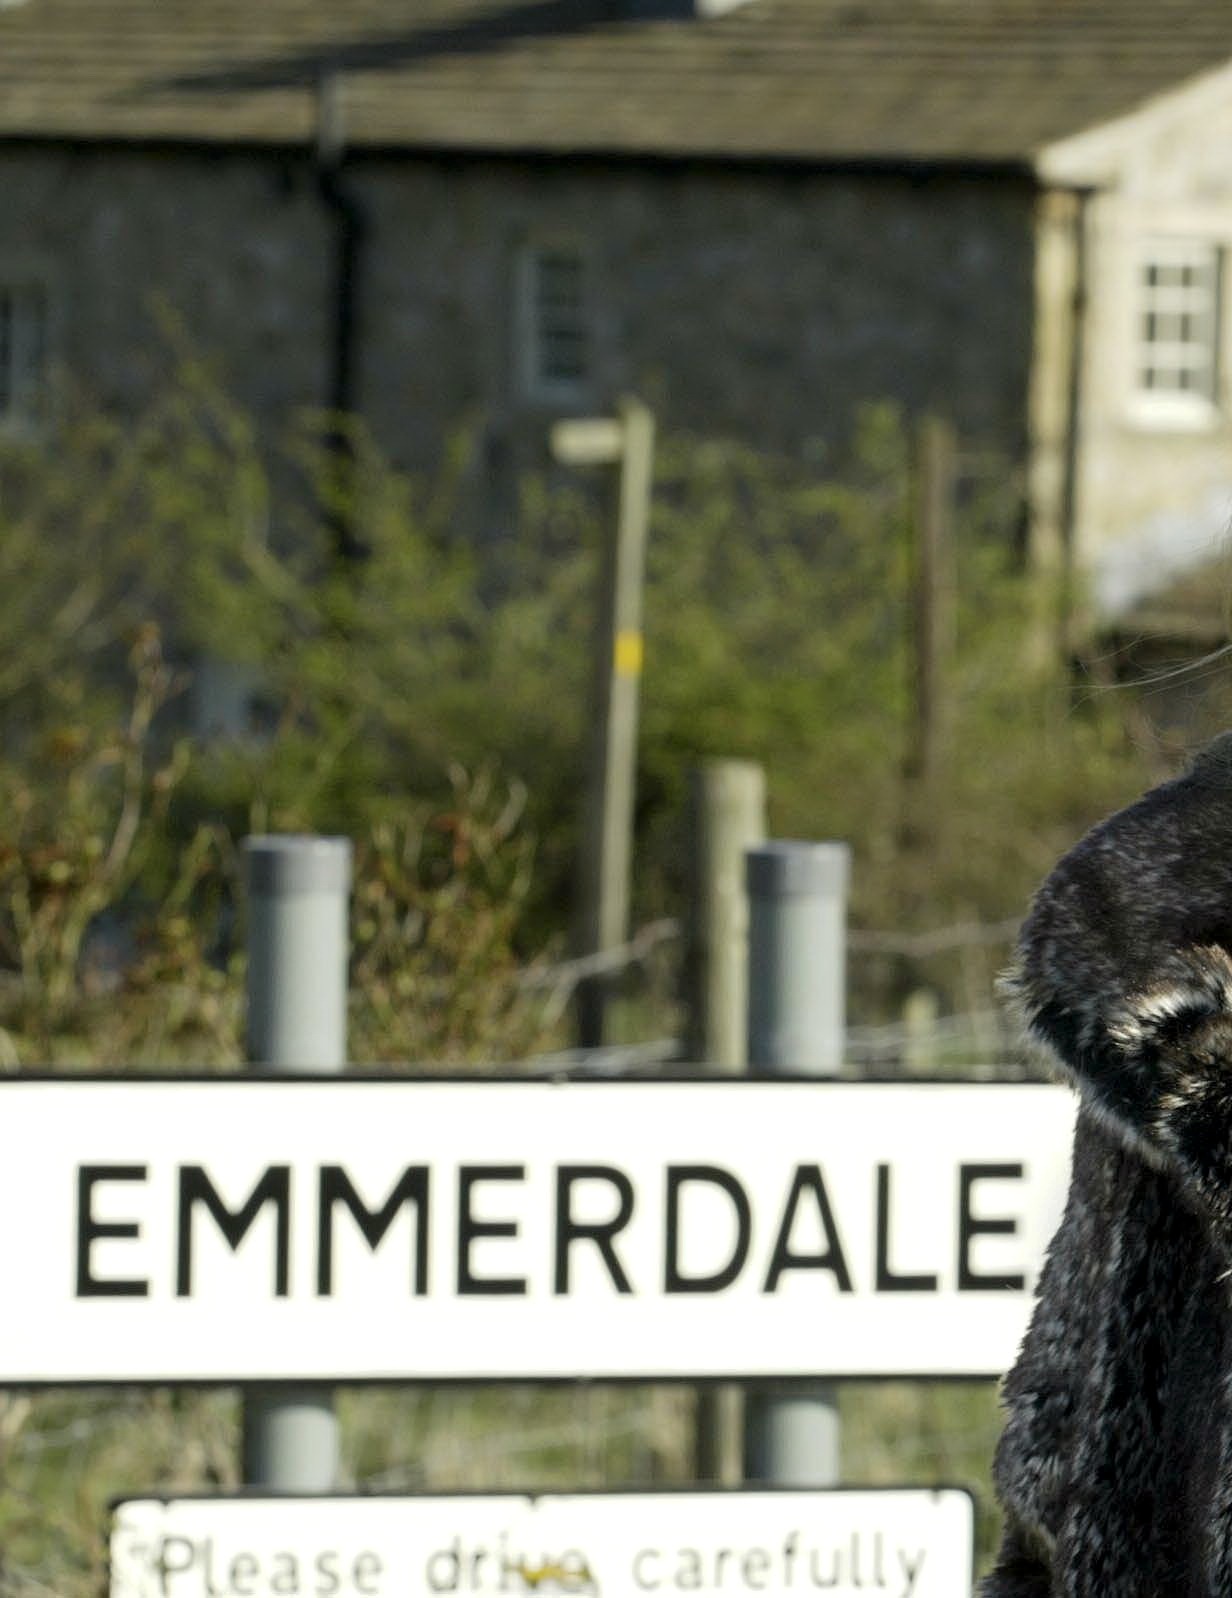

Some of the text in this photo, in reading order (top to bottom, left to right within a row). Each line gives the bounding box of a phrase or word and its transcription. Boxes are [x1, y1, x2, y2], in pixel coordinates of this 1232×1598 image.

[74, 1162, 1026, 1297] EMMERDALE
[159, 1530, 926, 1598] Please drive carefully
